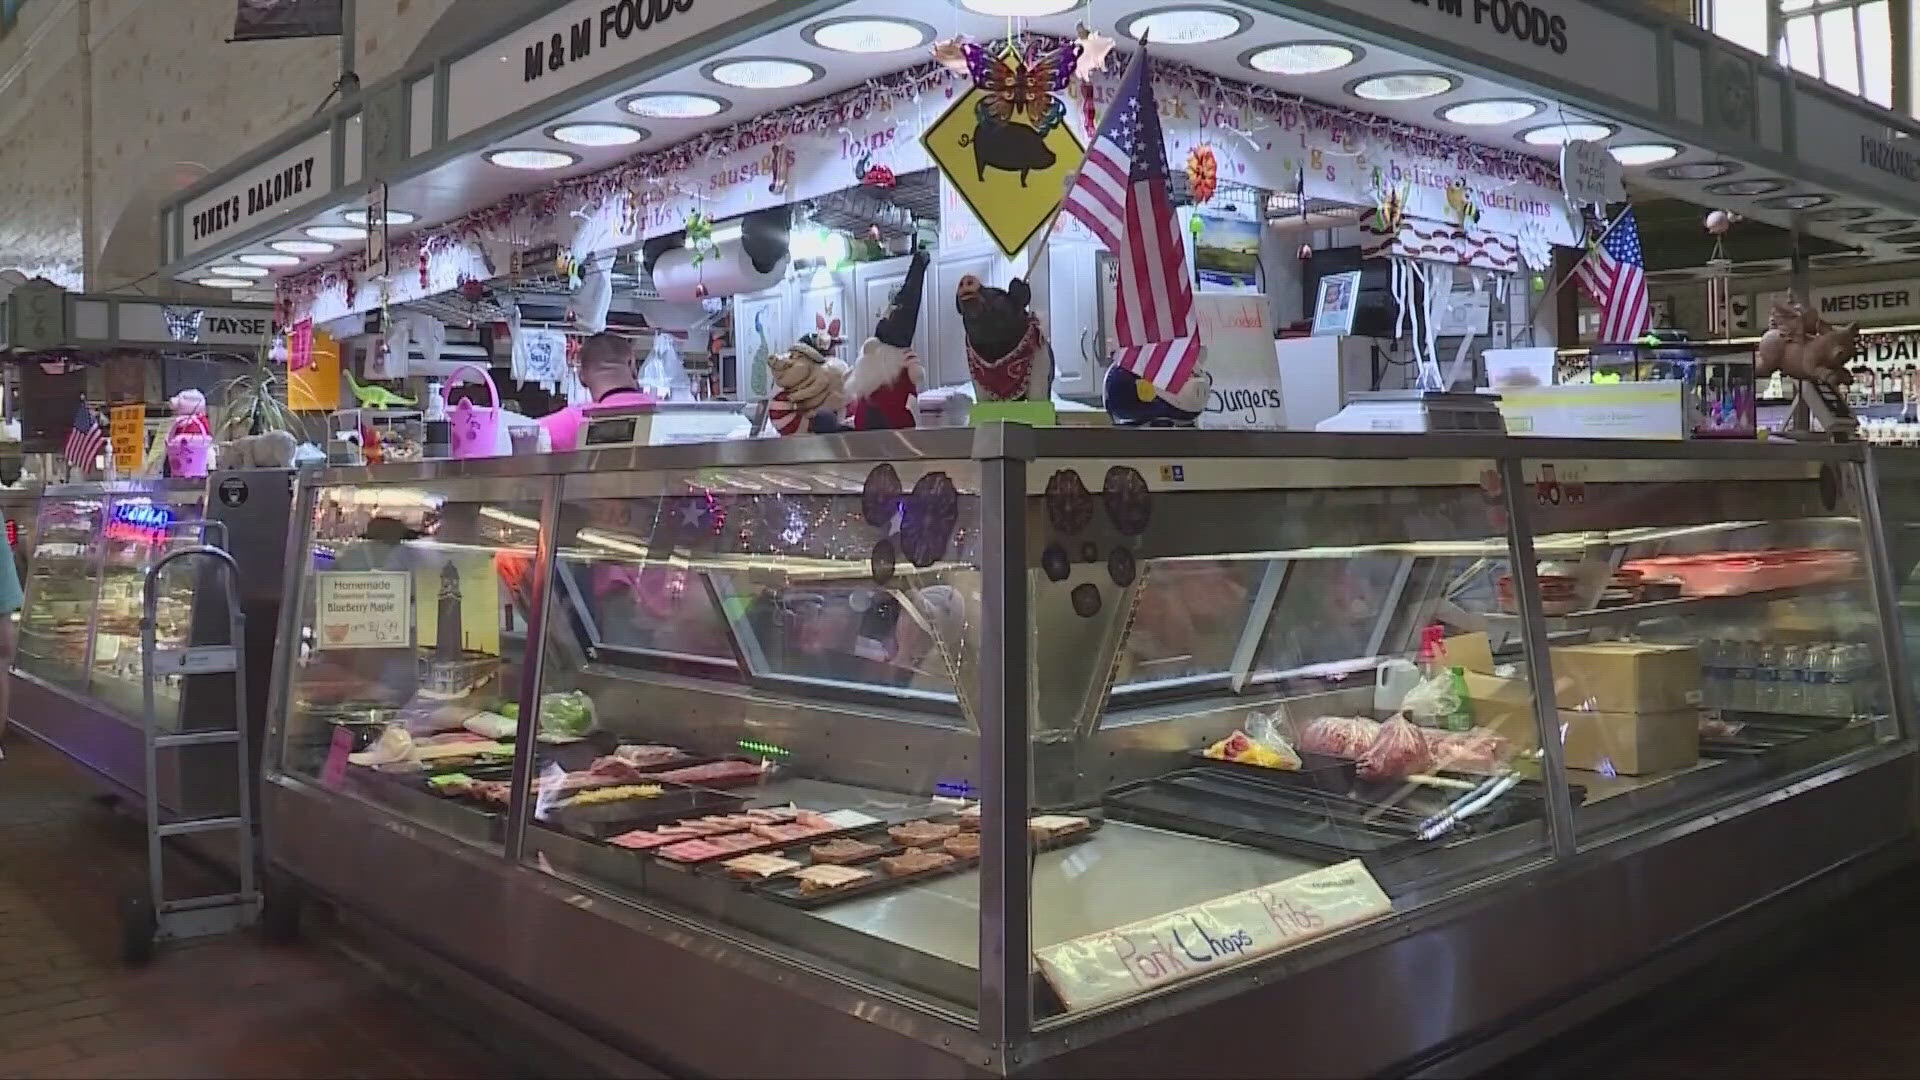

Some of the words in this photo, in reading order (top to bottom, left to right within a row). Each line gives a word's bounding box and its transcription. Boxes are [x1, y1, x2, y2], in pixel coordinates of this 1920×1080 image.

[524, 41, 543, 82] M
[549, 33, 564, 71] &
[571, 17, 591, 62] M
[838, 126, 896, 161] loins
[709, 151, 796, 191] sausags
[1821, 291, 1910, 313] MEISTER
[205, 317, 265, 334] TAYSE
[334, 581, 391, 591] Homemade
[1111, 935, 1188, 987] Pork
[1254, 889, 1326, 938] Ribs
